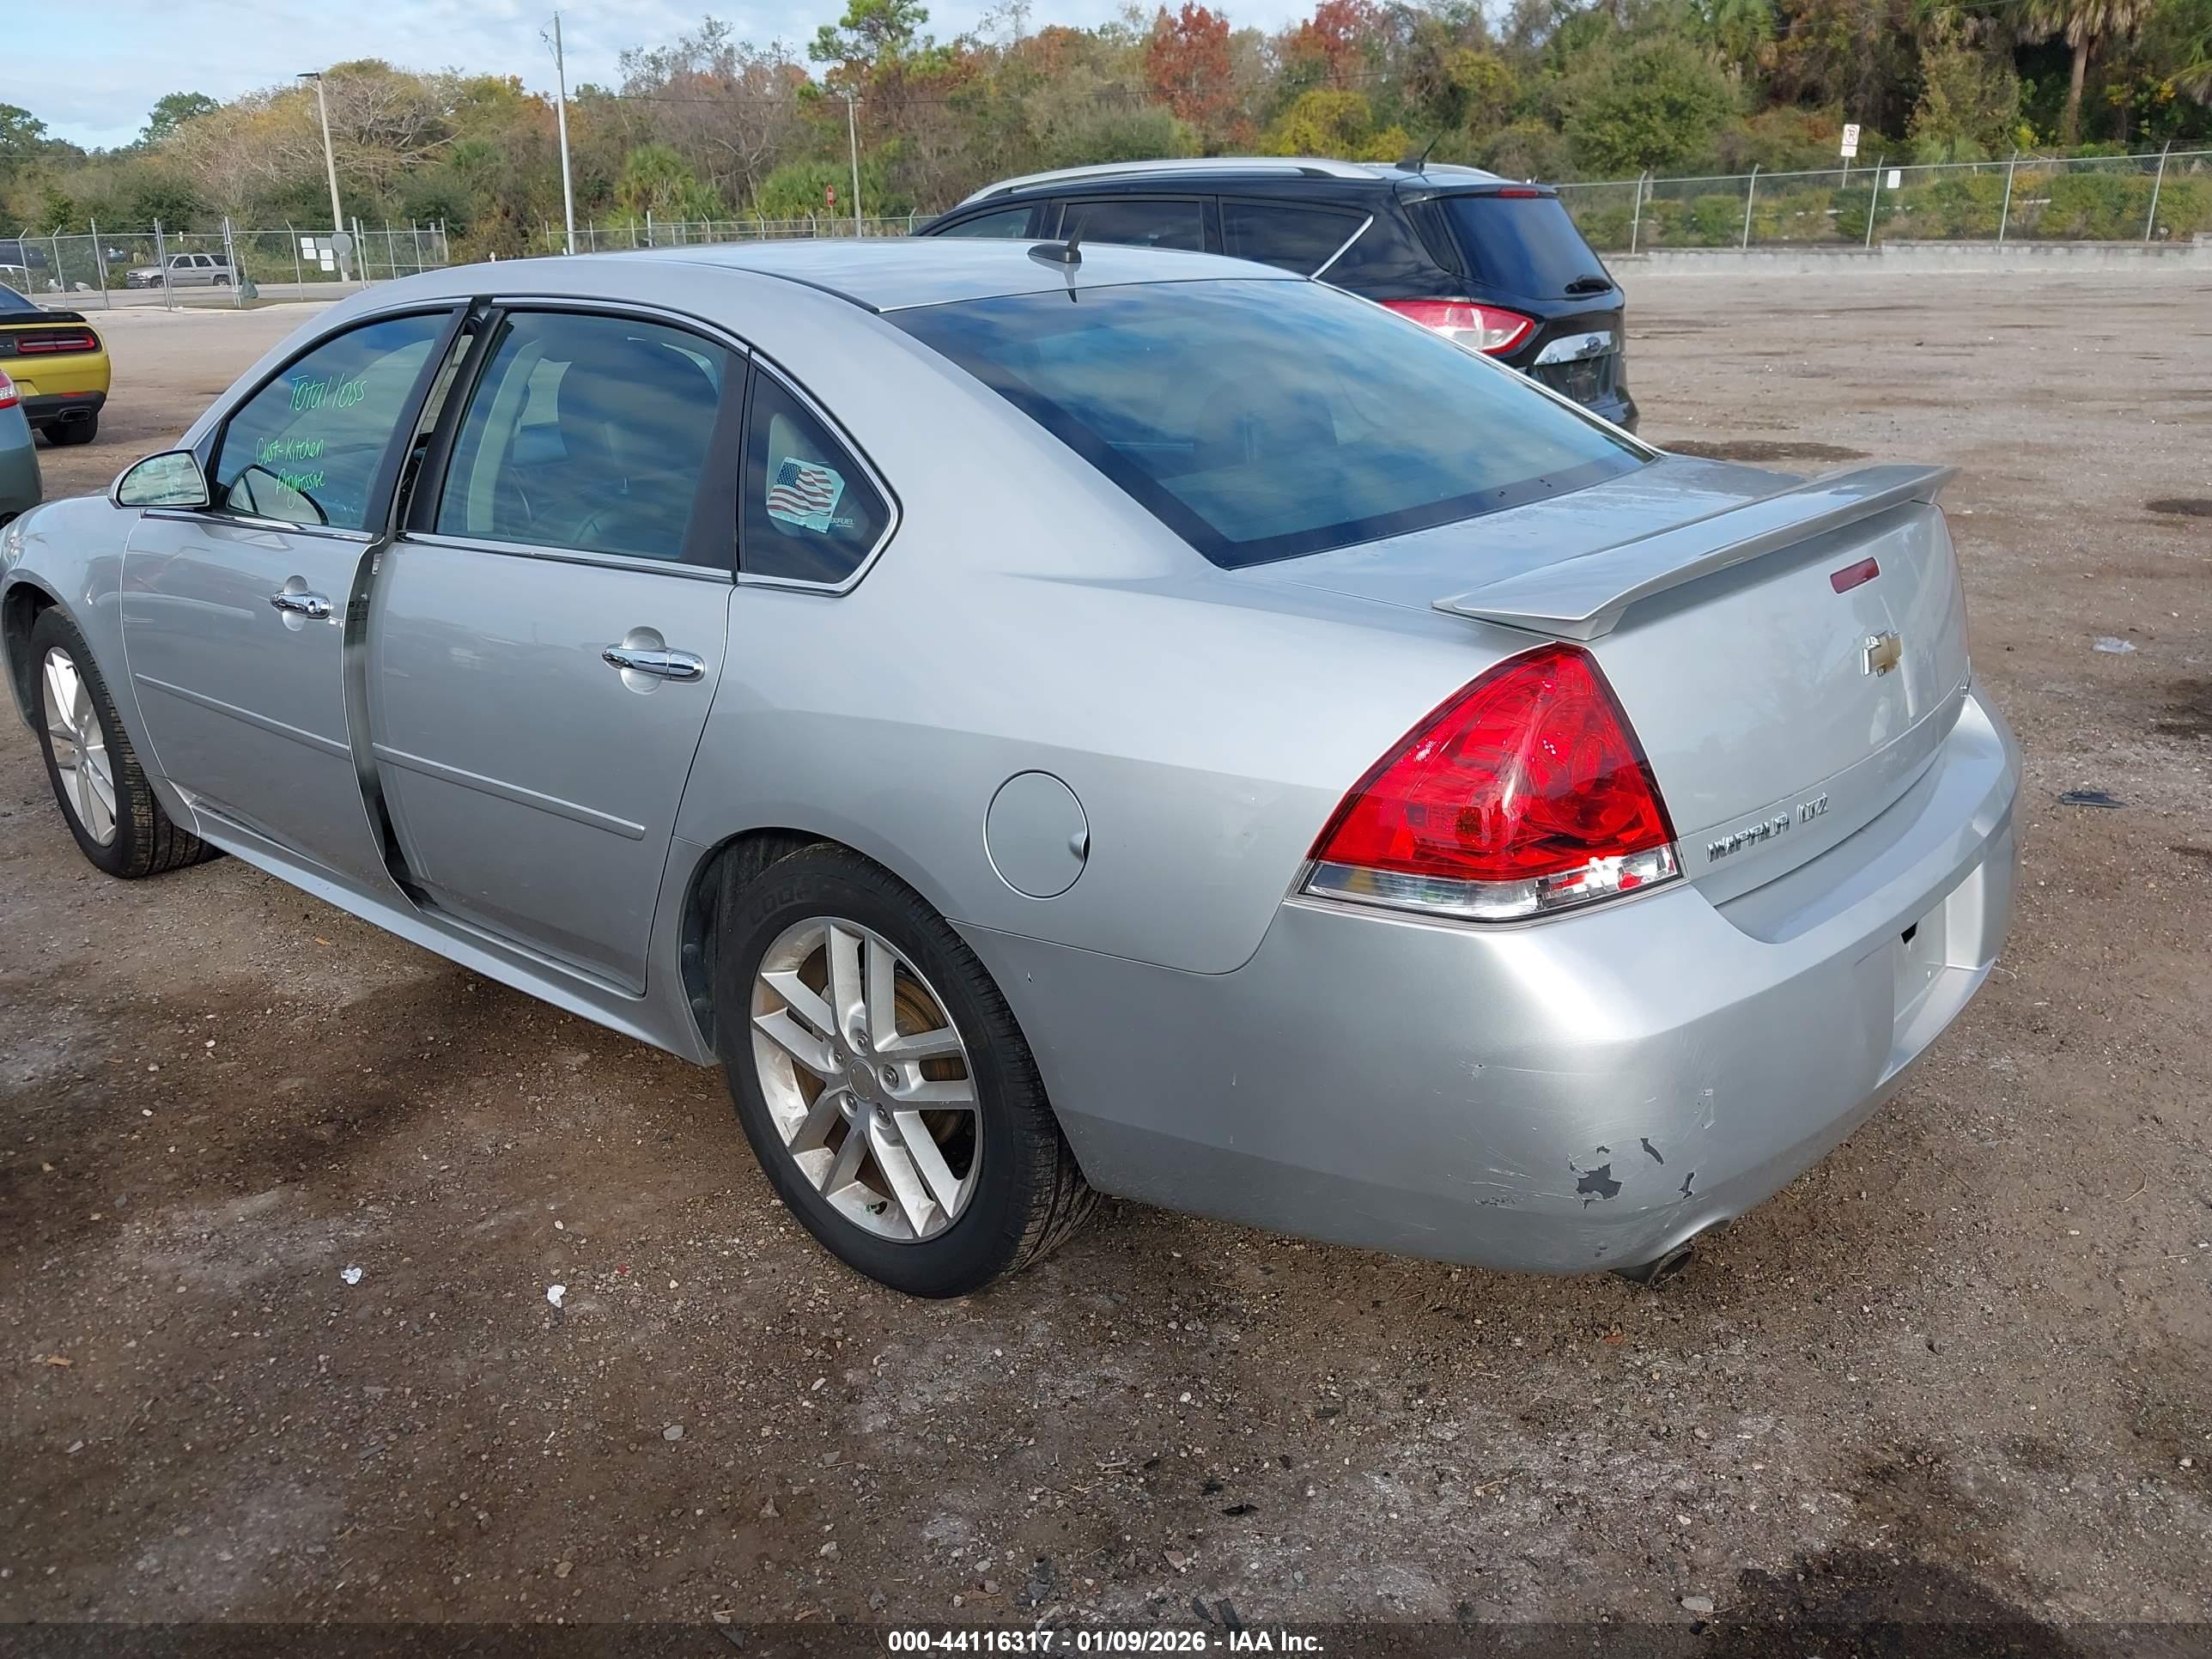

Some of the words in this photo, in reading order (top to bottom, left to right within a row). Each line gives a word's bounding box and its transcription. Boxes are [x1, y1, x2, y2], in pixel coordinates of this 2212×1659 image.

[289, 374, 332, 411] Total
[332, 373, 368, 409] loss
[276, 469, 325, 509] Progressive
[1706, 811, 1790, 862] IMPALA
[1797, 793, 1829, 824] LTZ
